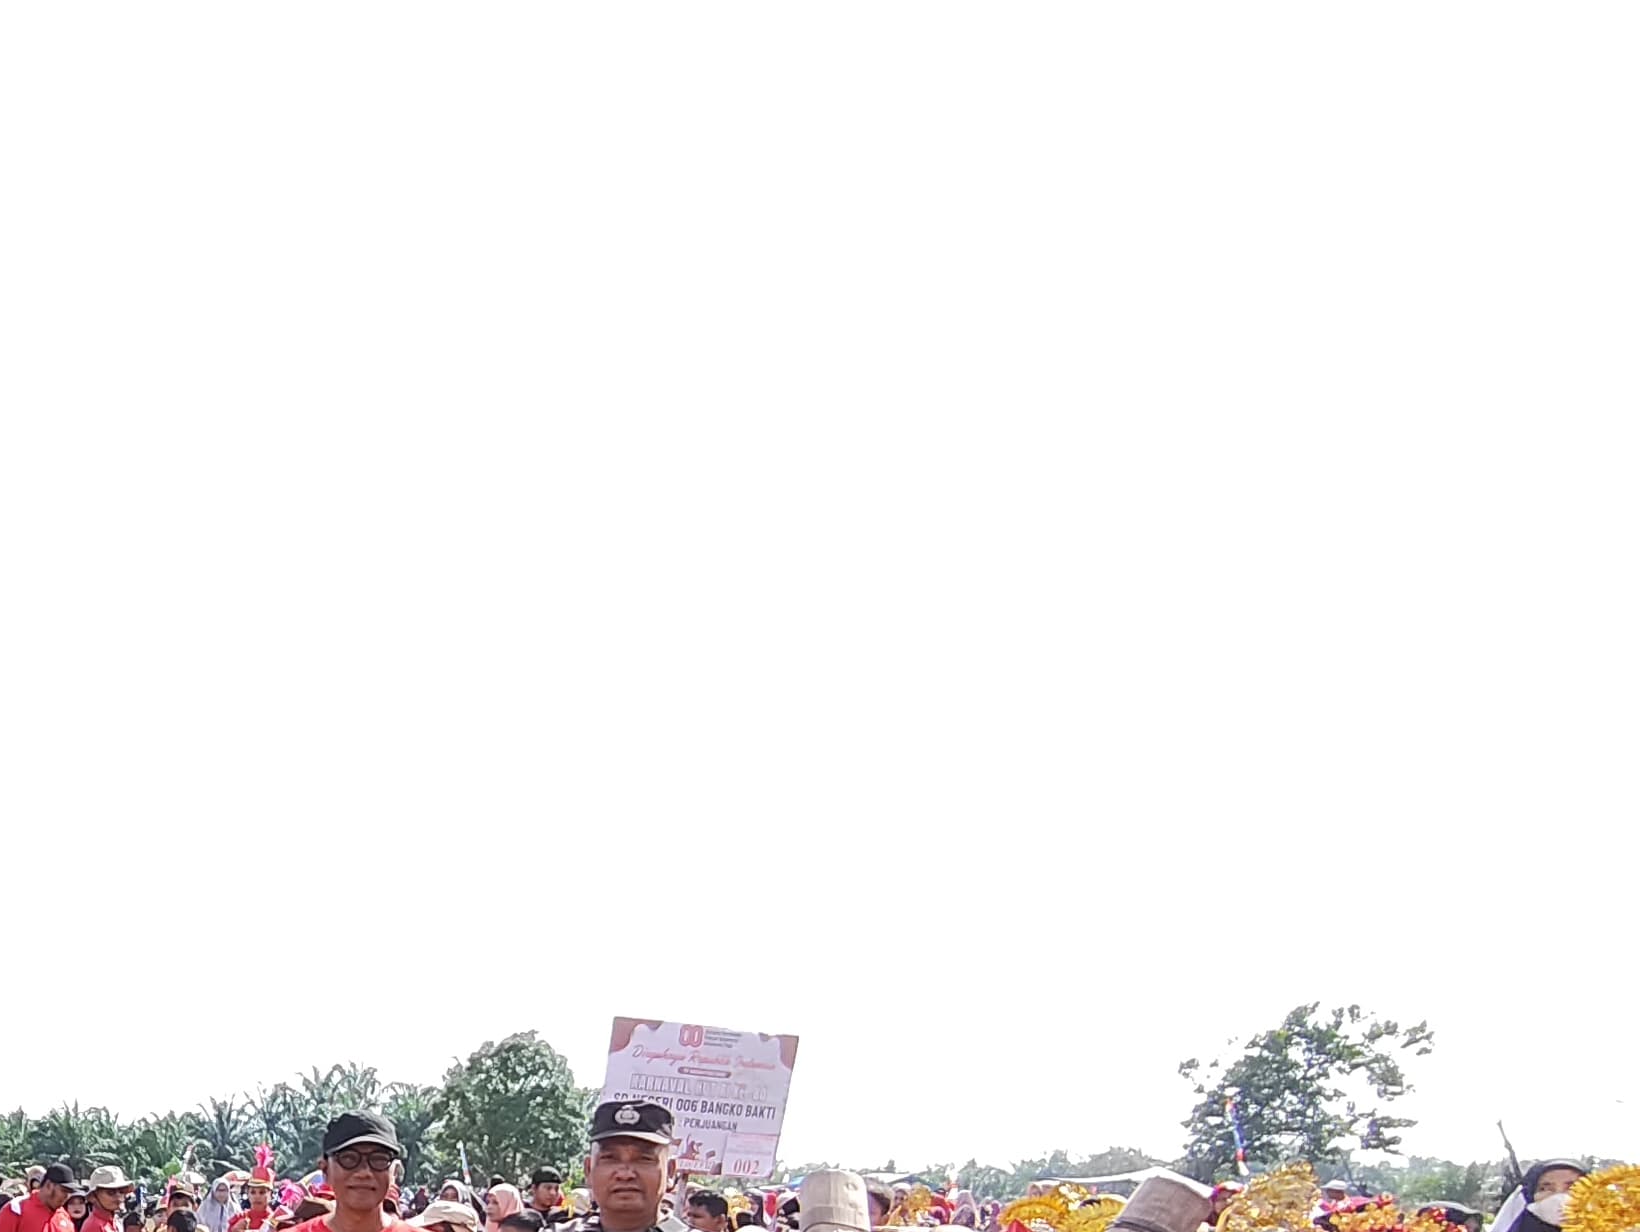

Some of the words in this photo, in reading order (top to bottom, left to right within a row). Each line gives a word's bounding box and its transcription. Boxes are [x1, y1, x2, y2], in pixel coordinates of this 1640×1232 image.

[676, 1098, 698, 1113] 006
[700, 1099, 743, 1118] BANGKO
[745, 1104, 777, 1120] BAKTI
[733, 1159, 759, 1175] 002
